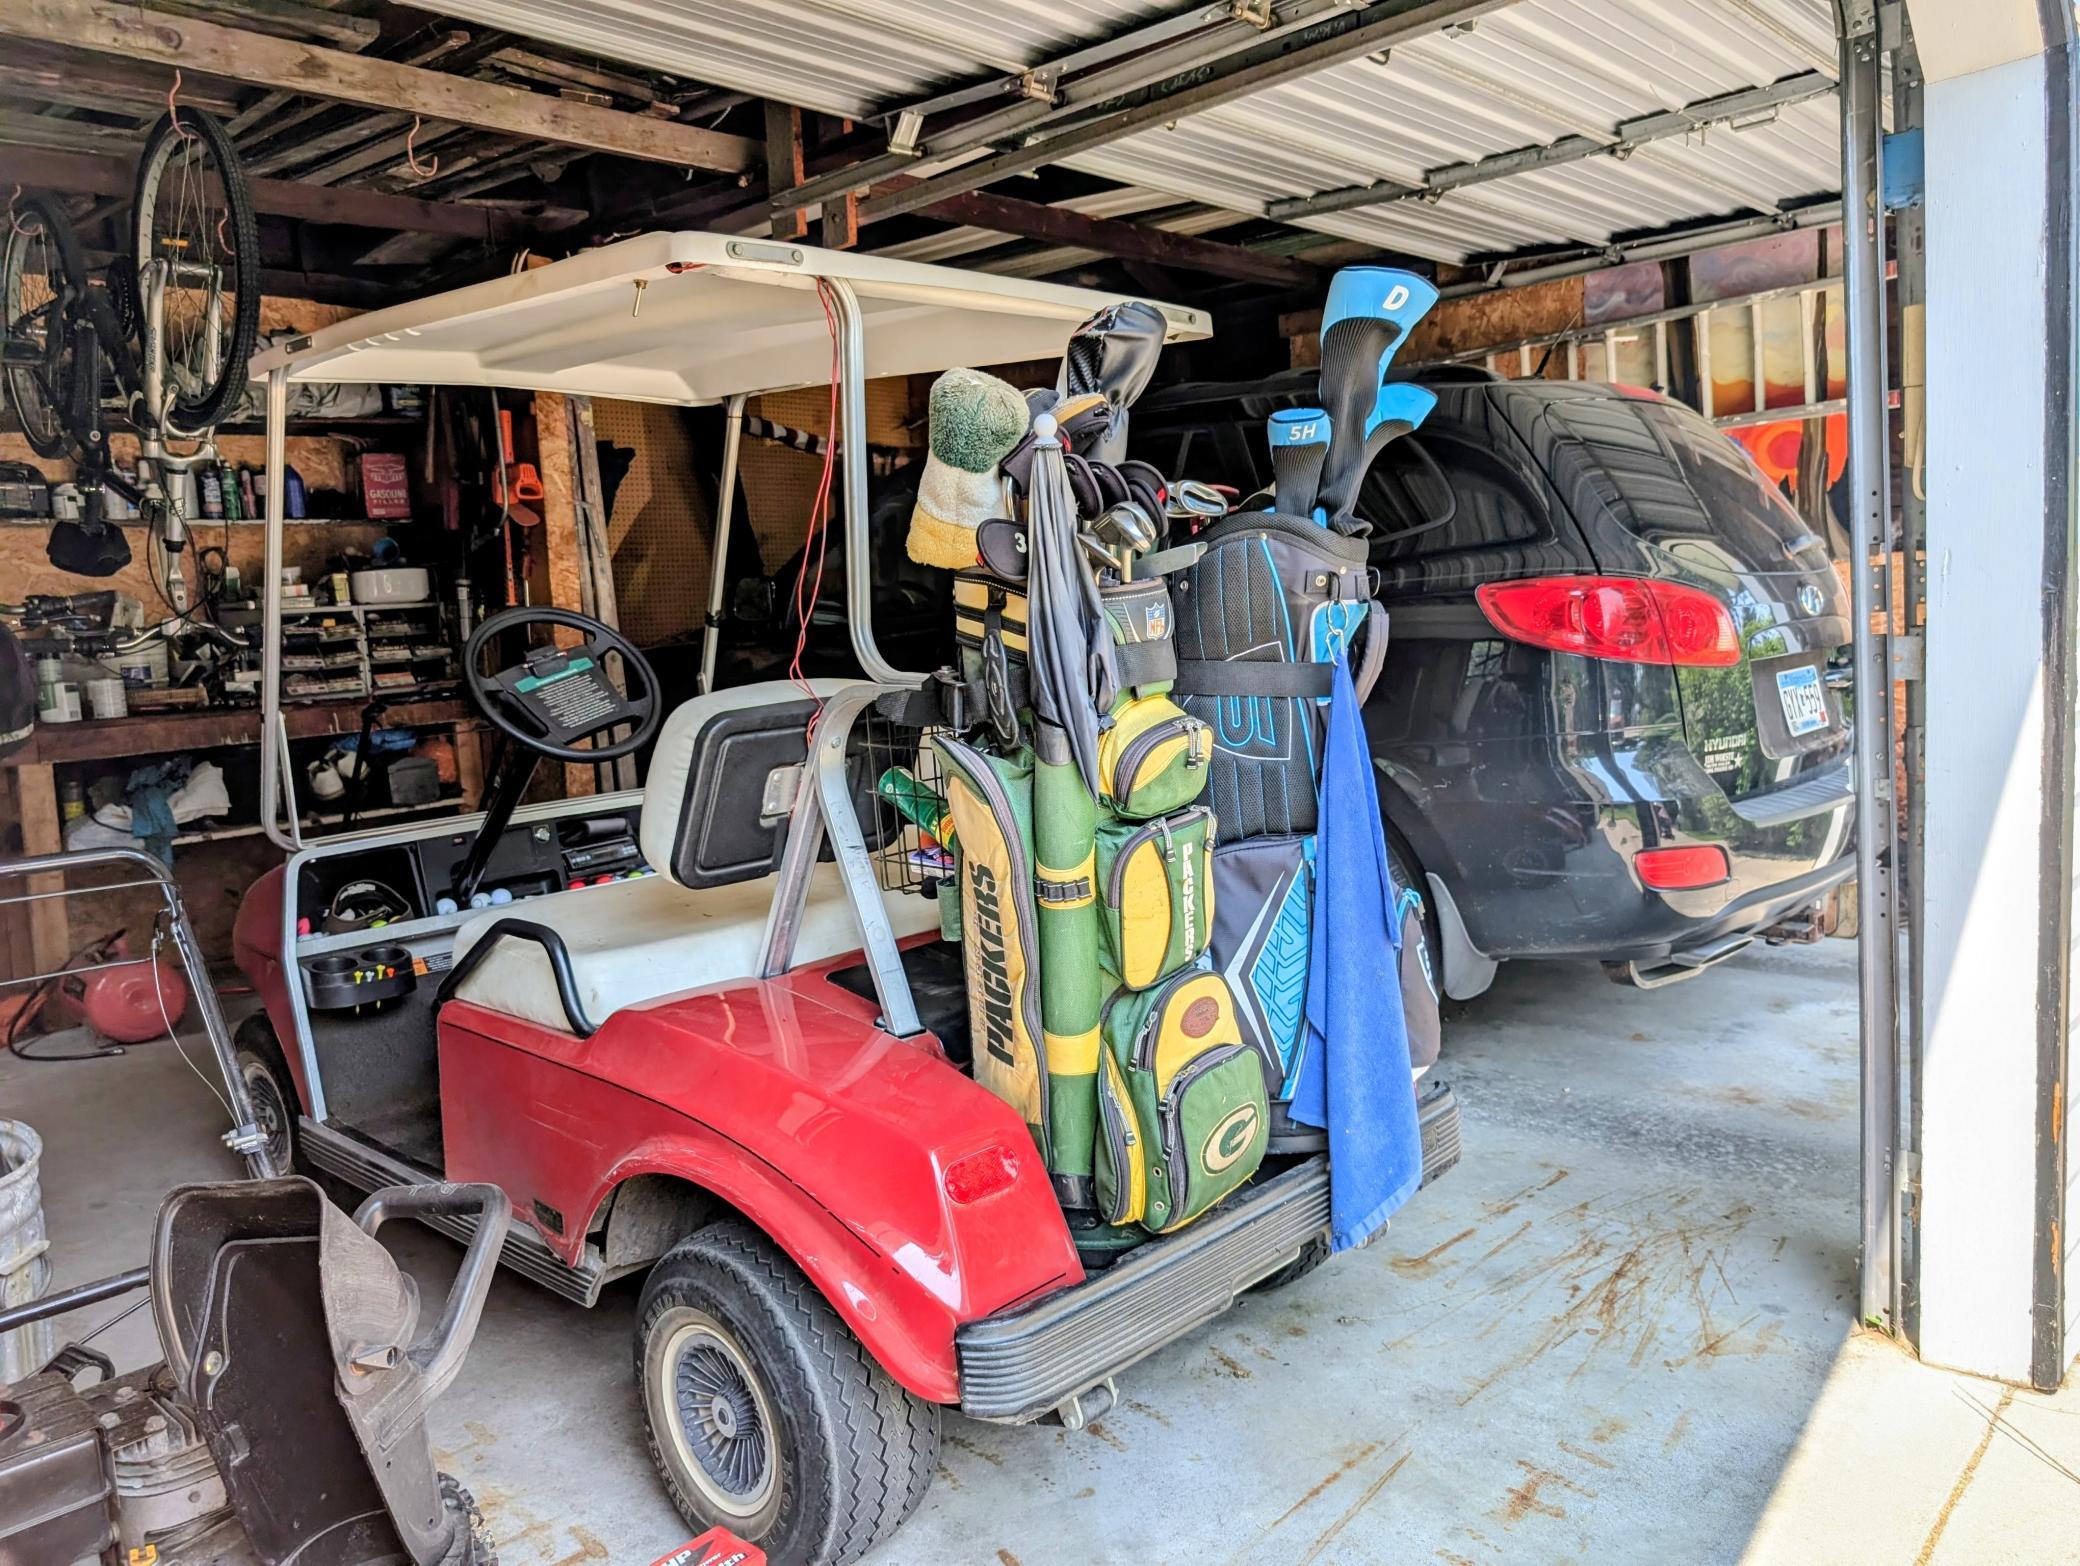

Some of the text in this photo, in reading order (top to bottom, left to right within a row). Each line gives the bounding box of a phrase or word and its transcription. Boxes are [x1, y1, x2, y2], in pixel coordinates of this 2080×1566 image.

[1382, 284, 1410, 311] D
[1289, 422, 1317, 441] 5H
[369, 489, 407, 499] GASOLINE
[1014, 532, 1028, 554] 3
[1704, 732, 1748, 752] HYUNDAI
[1182, 842, 1195, 962] PACKERS
[968, 860, 1015, 1068] PACKERS
[1204, 1105, 1259, 1172] G
